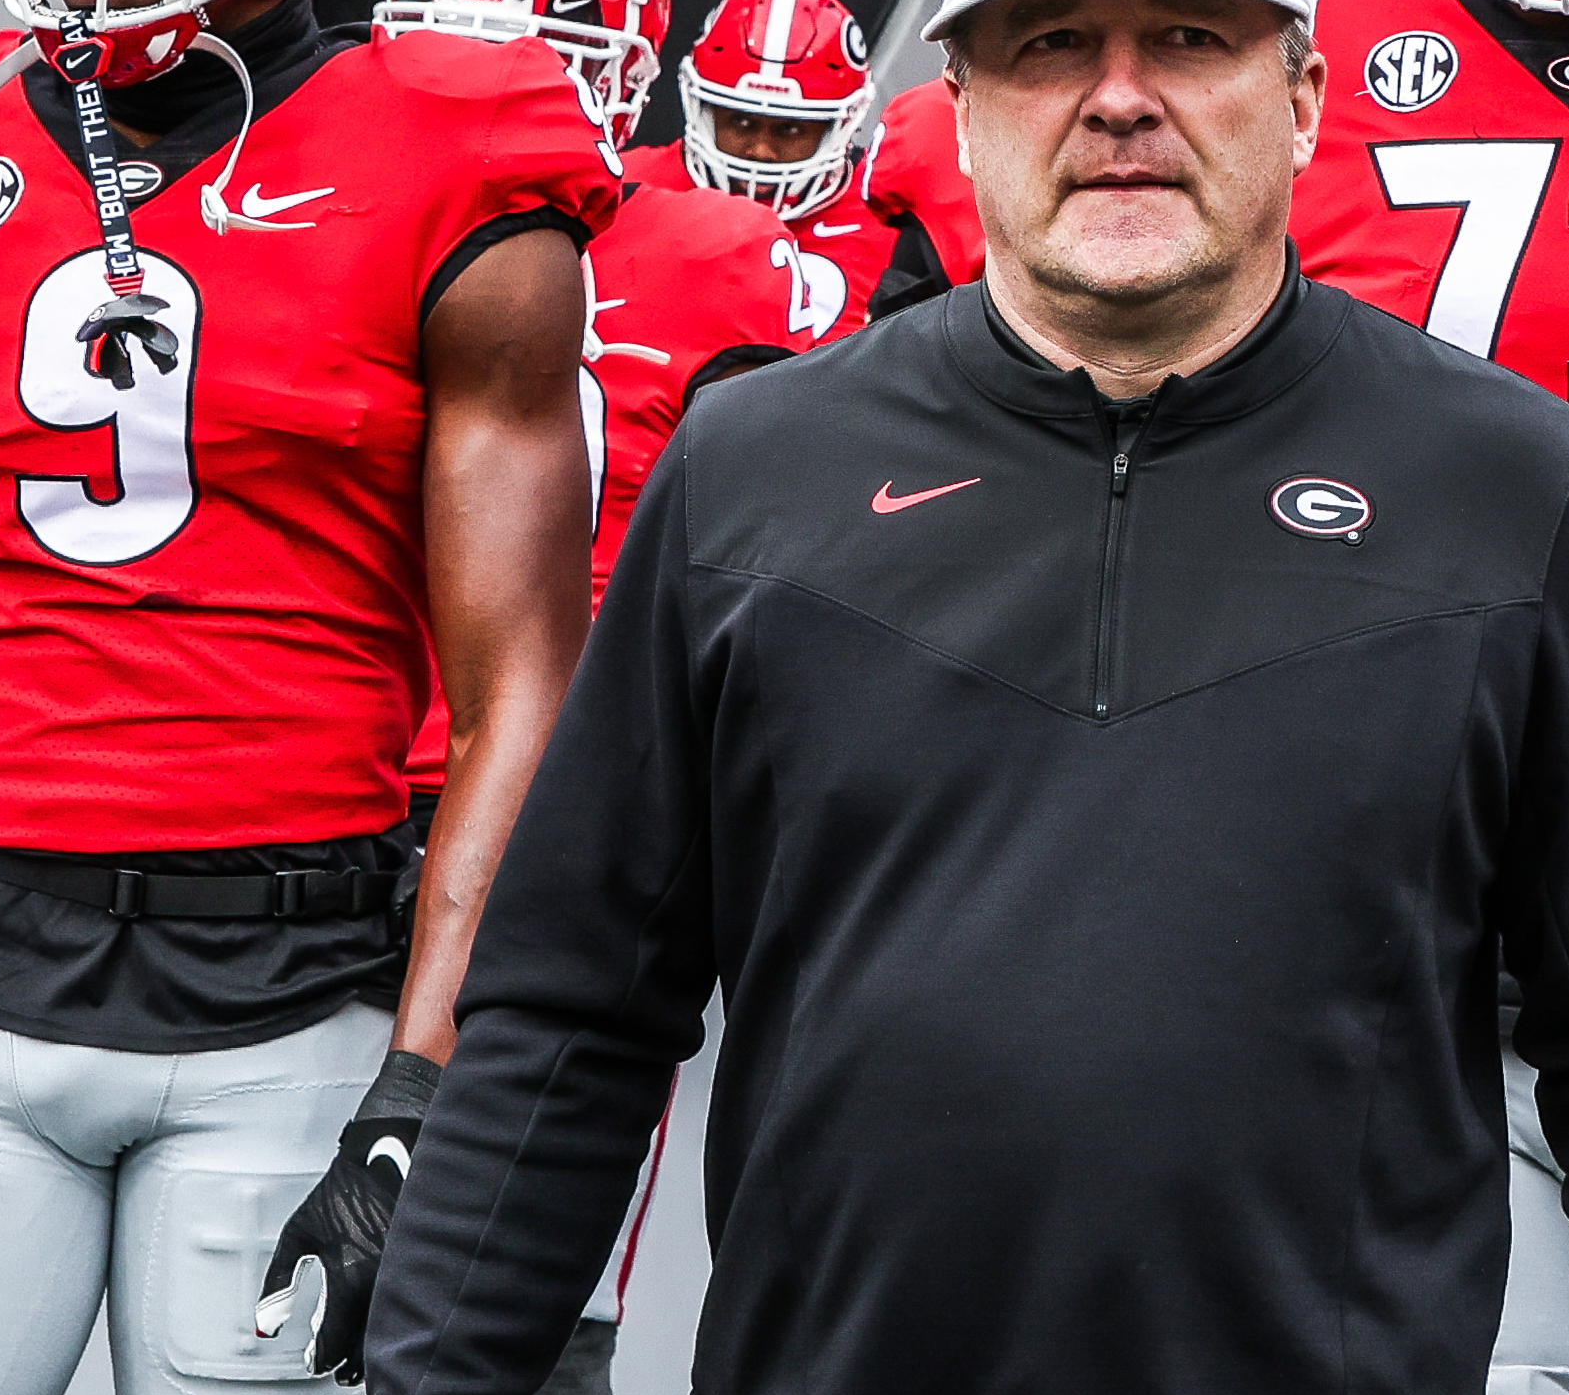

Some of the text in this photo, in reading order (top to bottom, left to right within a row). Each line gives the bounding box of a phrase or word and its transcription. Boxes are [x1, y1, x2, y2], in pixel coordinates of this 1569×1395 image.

[1372, 36, 1451, 108] SEC
[89, 152, 126, 226] 'BOUT
[18, 246, 200, 566] 9
[1266, 473, 1376, 545] G
